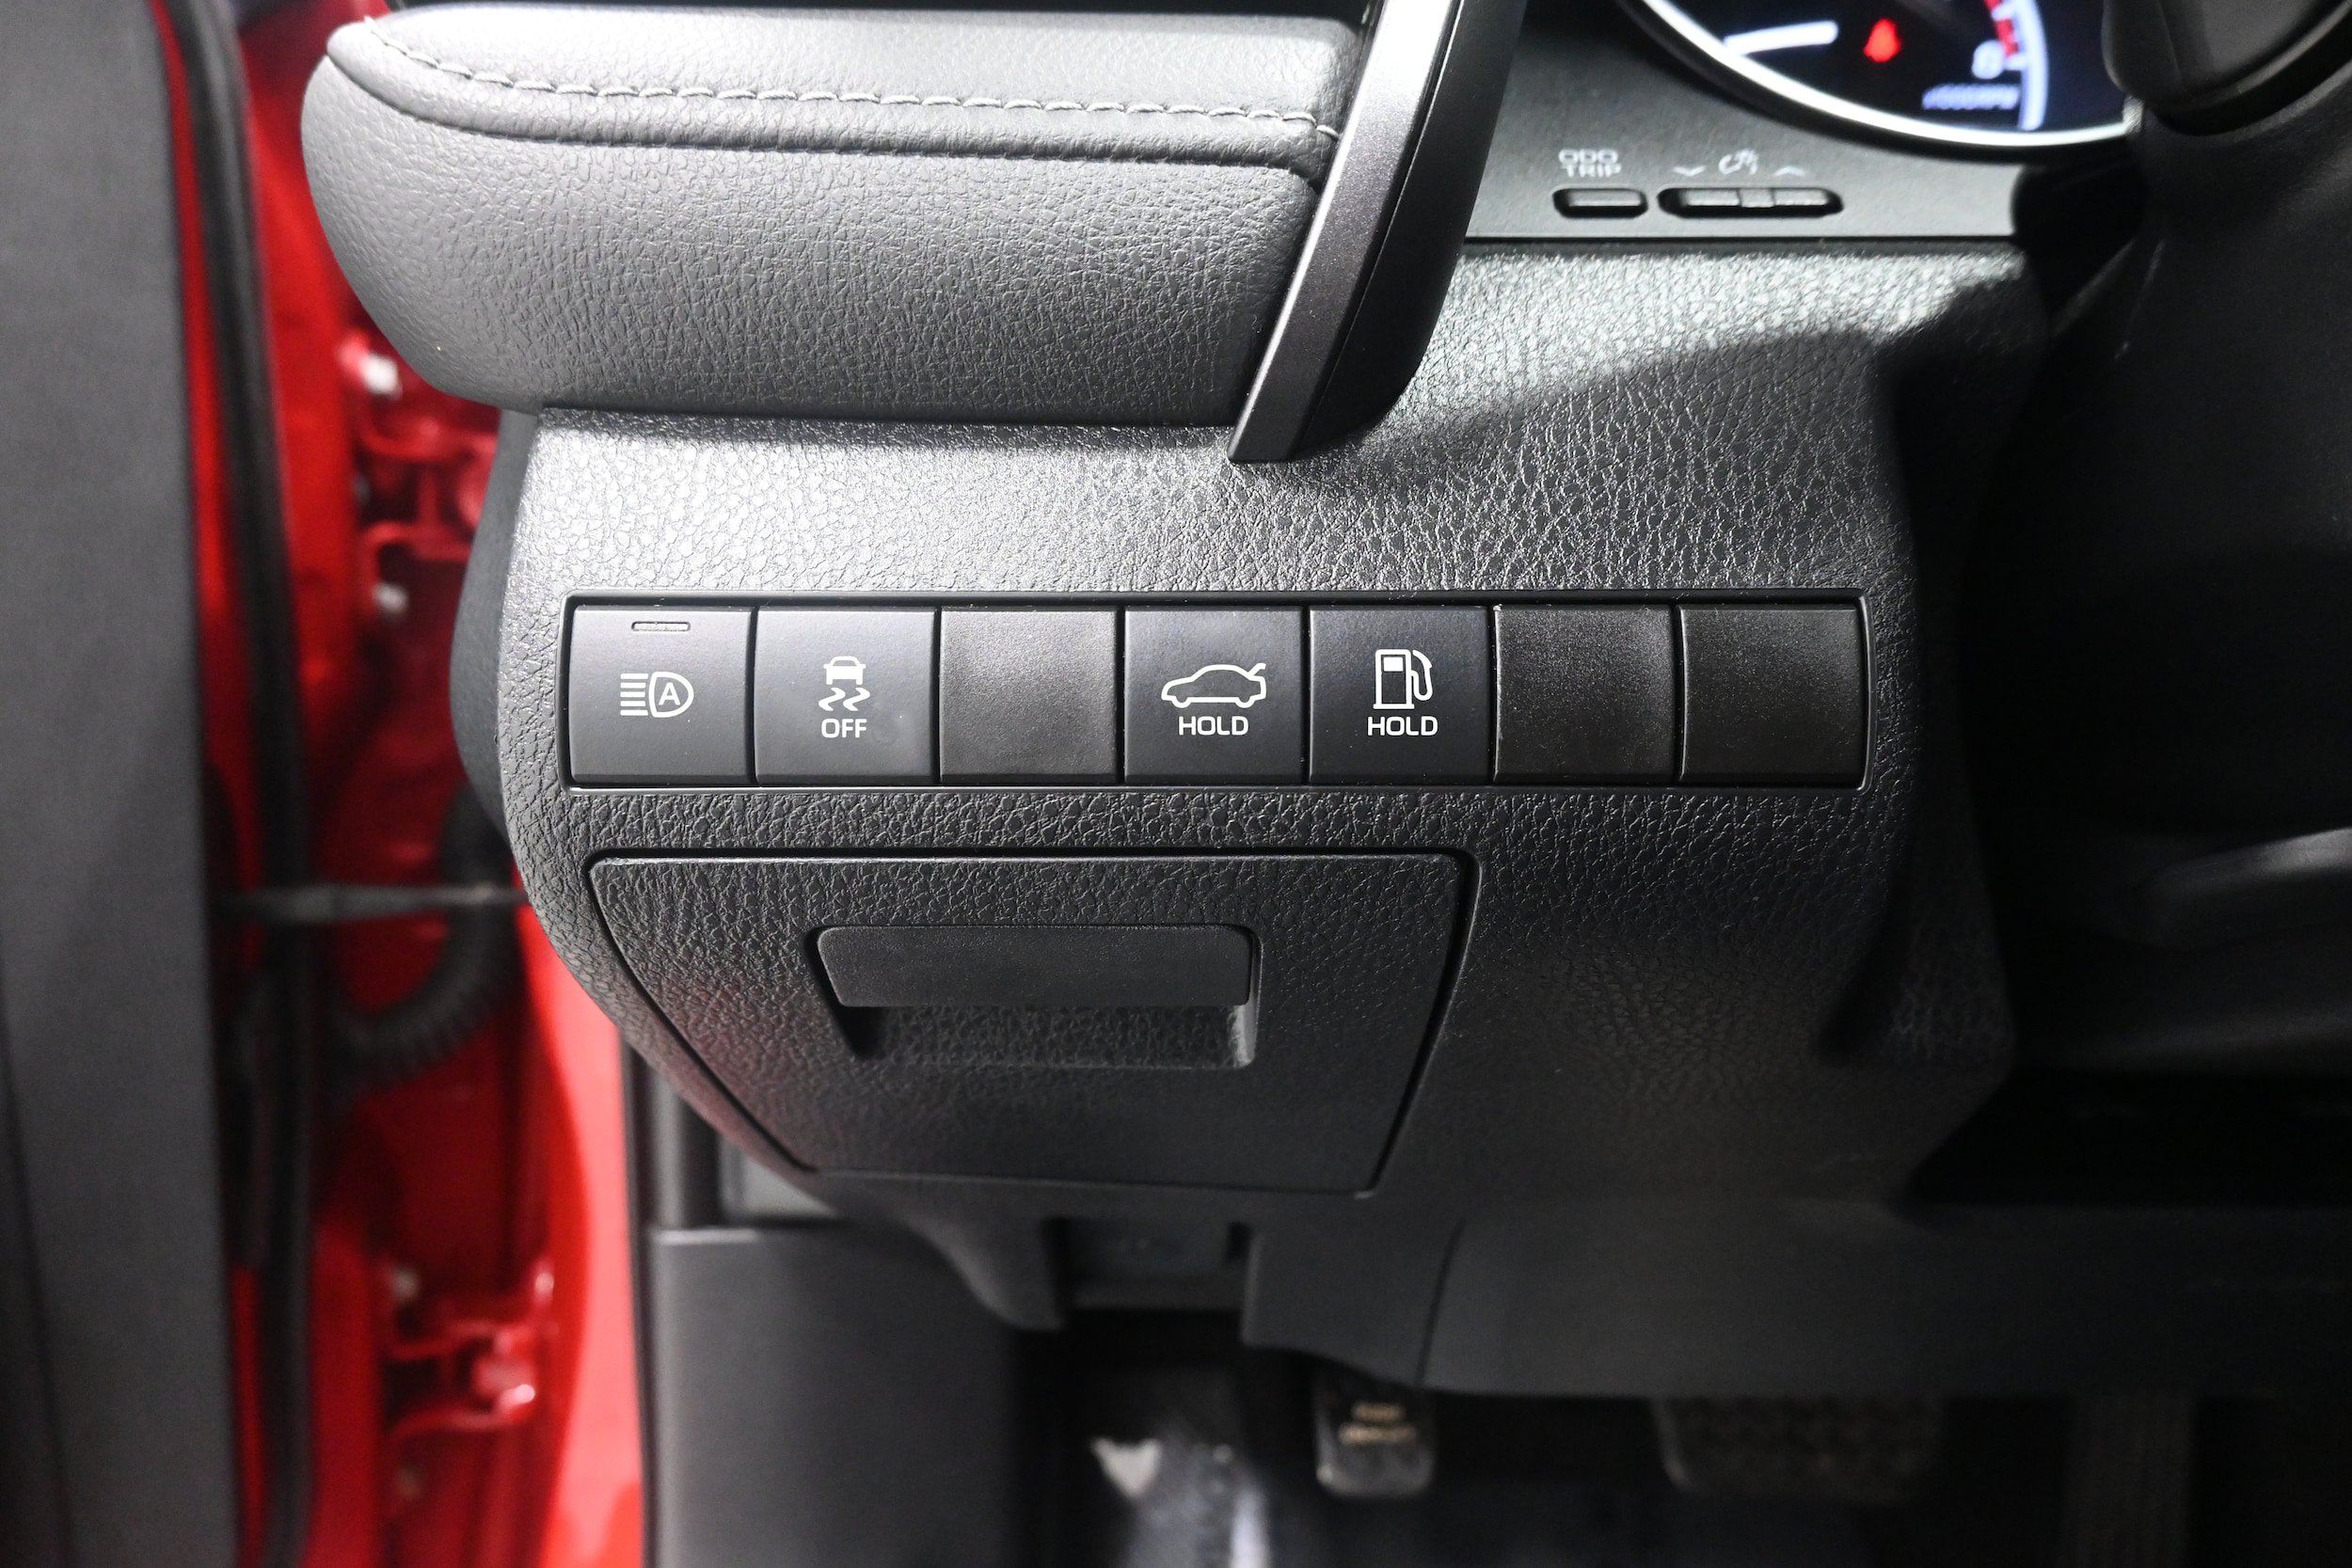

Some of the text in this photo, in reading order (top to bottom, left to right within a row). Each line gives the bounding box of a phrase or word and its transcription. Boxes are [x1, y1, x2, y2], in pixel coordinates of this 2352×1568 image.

[1558, 148, 1618, 164] ODO
[1561, 164, 1622, 178] TRIP
[821, 718, 867, 738] OFF
[1178, 716, 1249, 736] HOLD
[1366, 716, 1438, 736] HOLD
